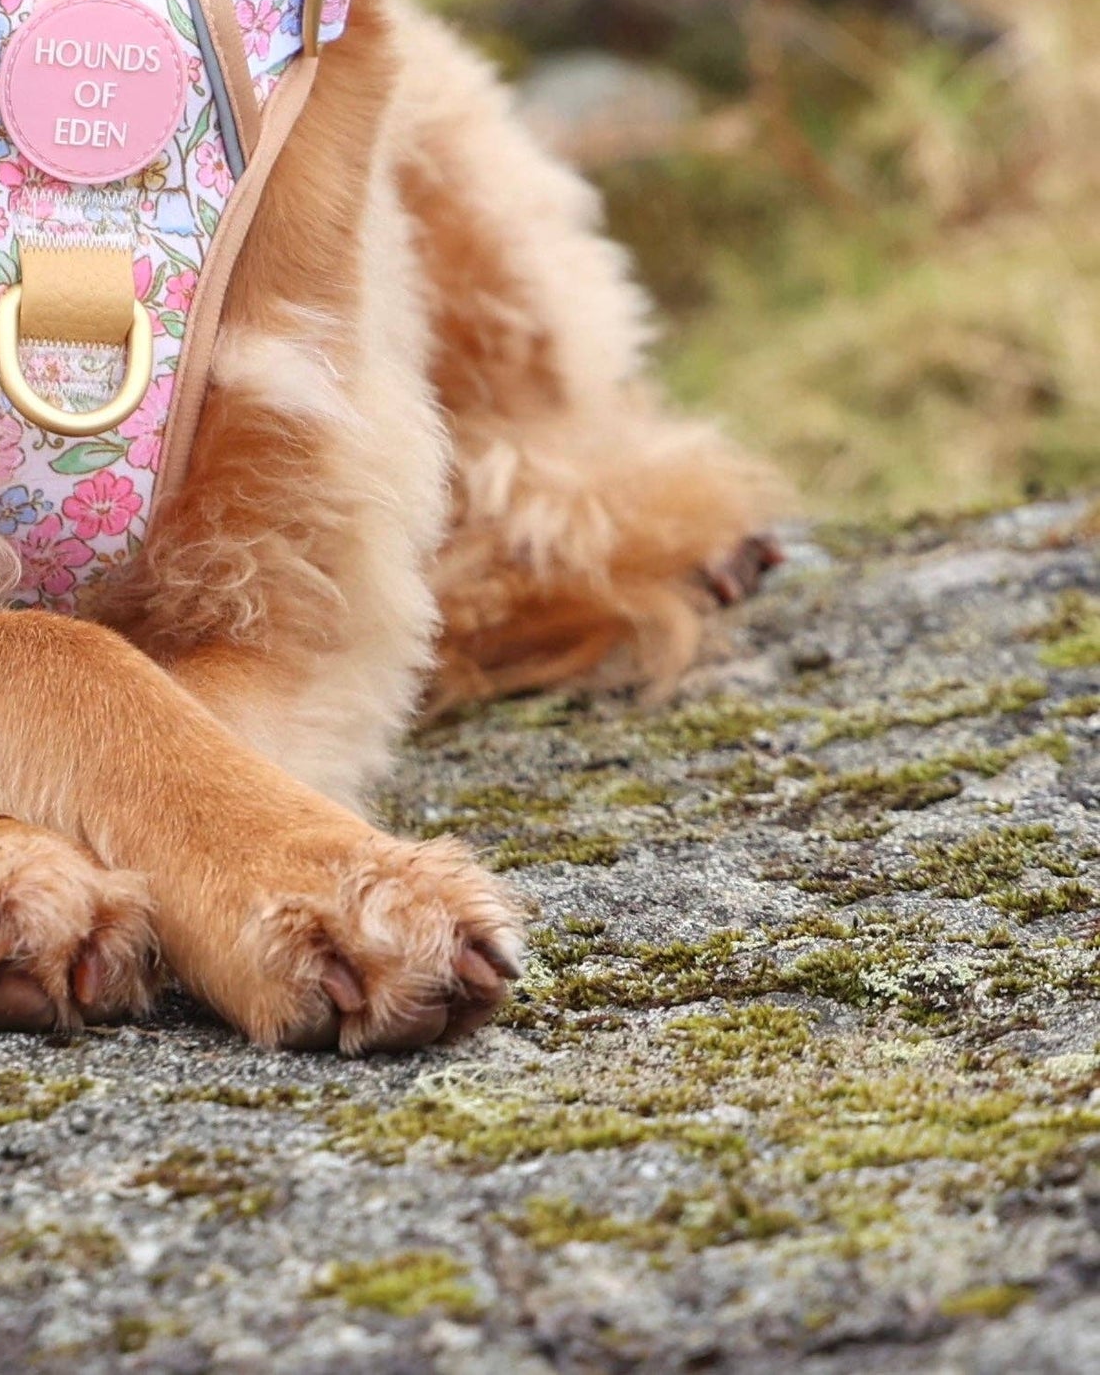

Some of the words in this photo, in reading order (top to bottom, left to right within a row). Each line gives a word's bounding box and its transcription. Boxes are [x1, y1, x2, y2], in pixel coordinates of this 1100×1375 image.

[34, 37, 161, 73] HOUNDS
[74, 80, 118, 109] OF
[54, 117, 127, 148] EDEN
